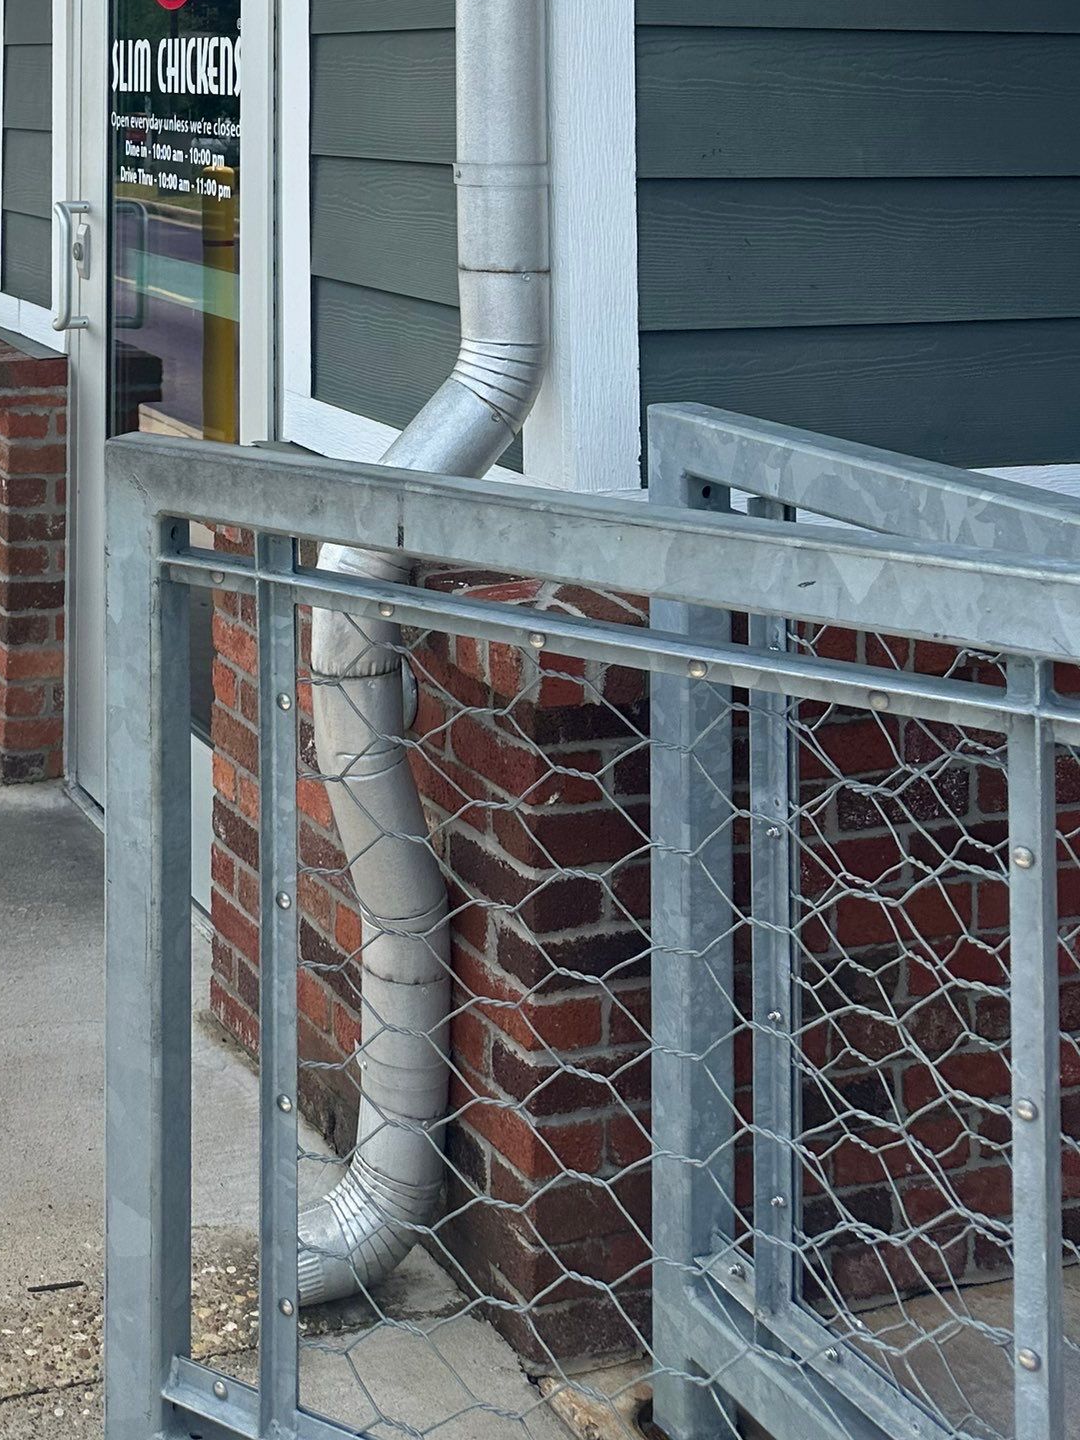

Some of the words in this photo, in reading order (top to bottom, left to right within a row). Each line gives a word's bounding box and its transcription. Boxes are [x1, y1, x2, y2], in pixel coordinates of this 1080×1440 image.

[112, 38, 151, 92] SLIM
[157, 36, 241, 97] CHICKENS
[111, 111, 129, 131] Open
[130, 113, 163, 134] everyday
[163, 114, 189, 133] unless
[189, 117, 212, 135] we're
[213, 117, 241, 137] closed
[125, 140, 140, 157] Dine
[140, 141, 148, 158] in
[152, 143, 172, 161] 10:00
[172, 149, 184, 163] am
[189, 147, 211, 166] 10:00
[212, 153, 225, 171] pm
[120, 165, 137, 184] Drive
[137, 168, 154, 186] Thru
[158, 172, 178, 190] 10:00
[178, 178, 190, 192] am
[196, 177, 217, 197] 11:00
[218, 184, 231, 202] pm
